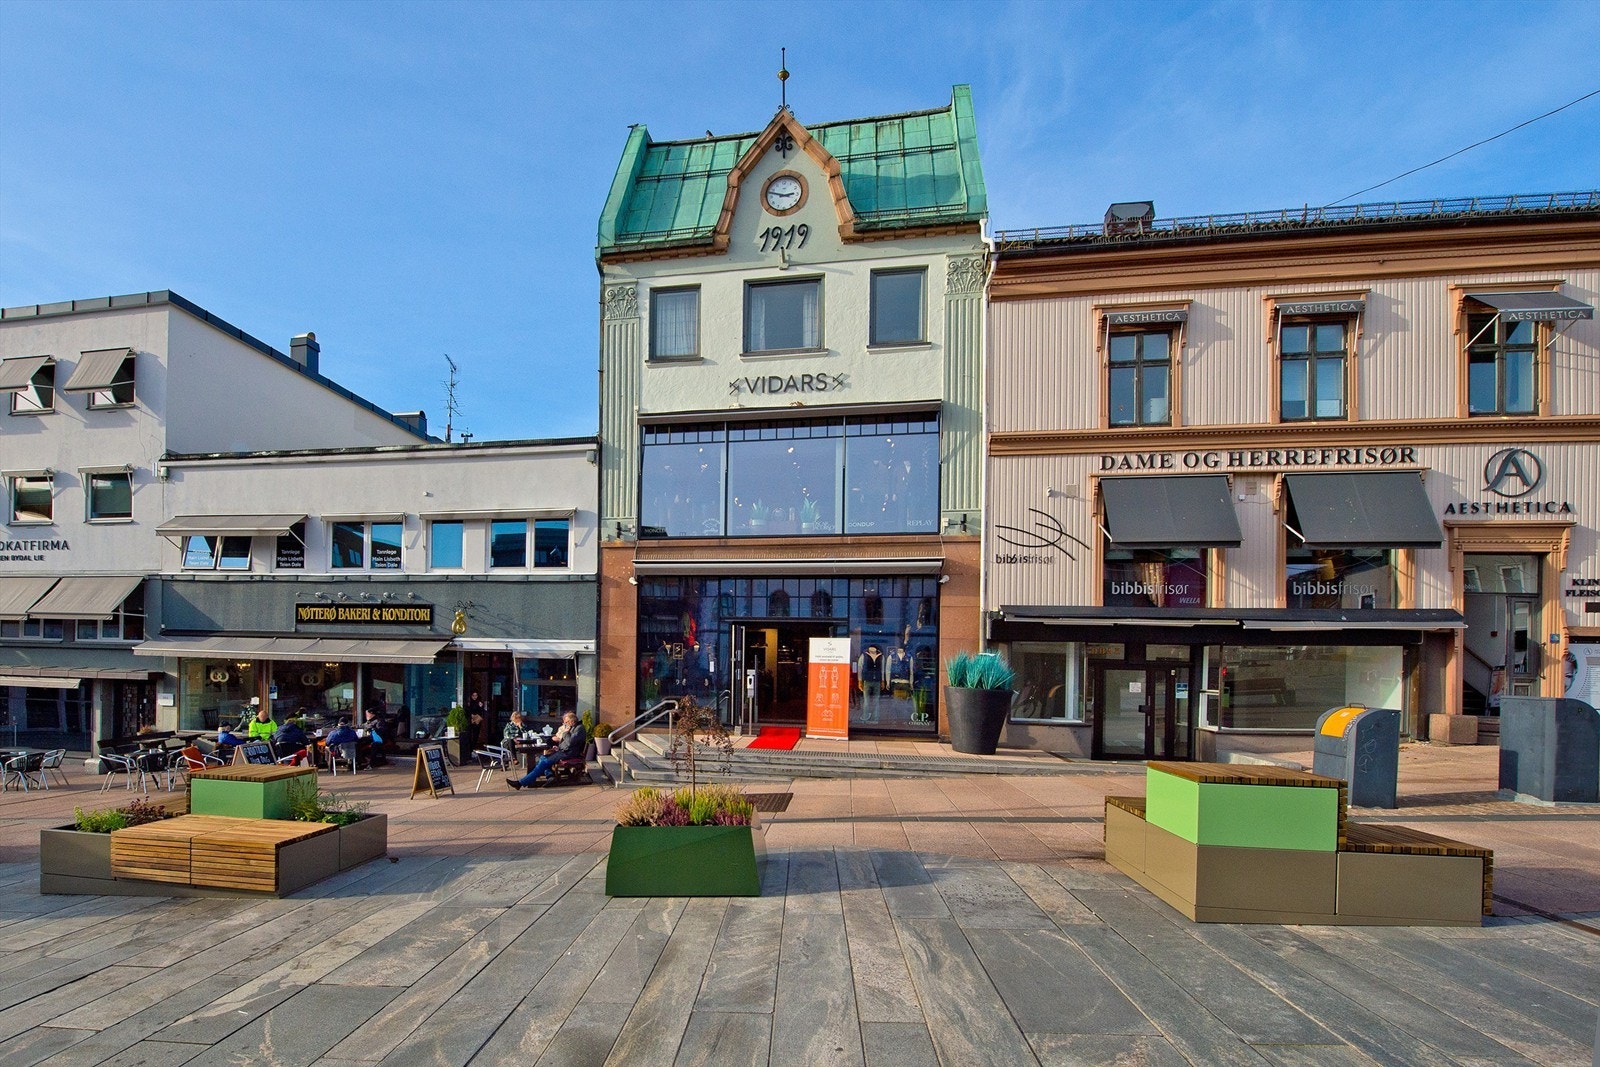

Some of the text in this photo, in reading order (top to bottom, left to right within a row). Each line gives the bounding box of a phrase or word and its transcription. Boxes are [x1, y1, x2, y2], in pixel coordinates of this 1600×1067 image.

[760, 223, 808, 252] 1919
[1286, 303, 1356, 314] AESTHETICA
[1508, 310, 1586, 320] AESTHETICA
[1115, 312, 1180, 323] AESTHETICA
[744, 372, 828, 394] VIDARS
[1100, 447, 1416, 471] DAME OG HERREFRISØR
[1444, 501, 1572, 515] AESTHETICA
[1111, 581, 1189, 595] bibbisfrisør
[298, 607, 431, 622] NØTTERØ BAKERI & KONDITORI
